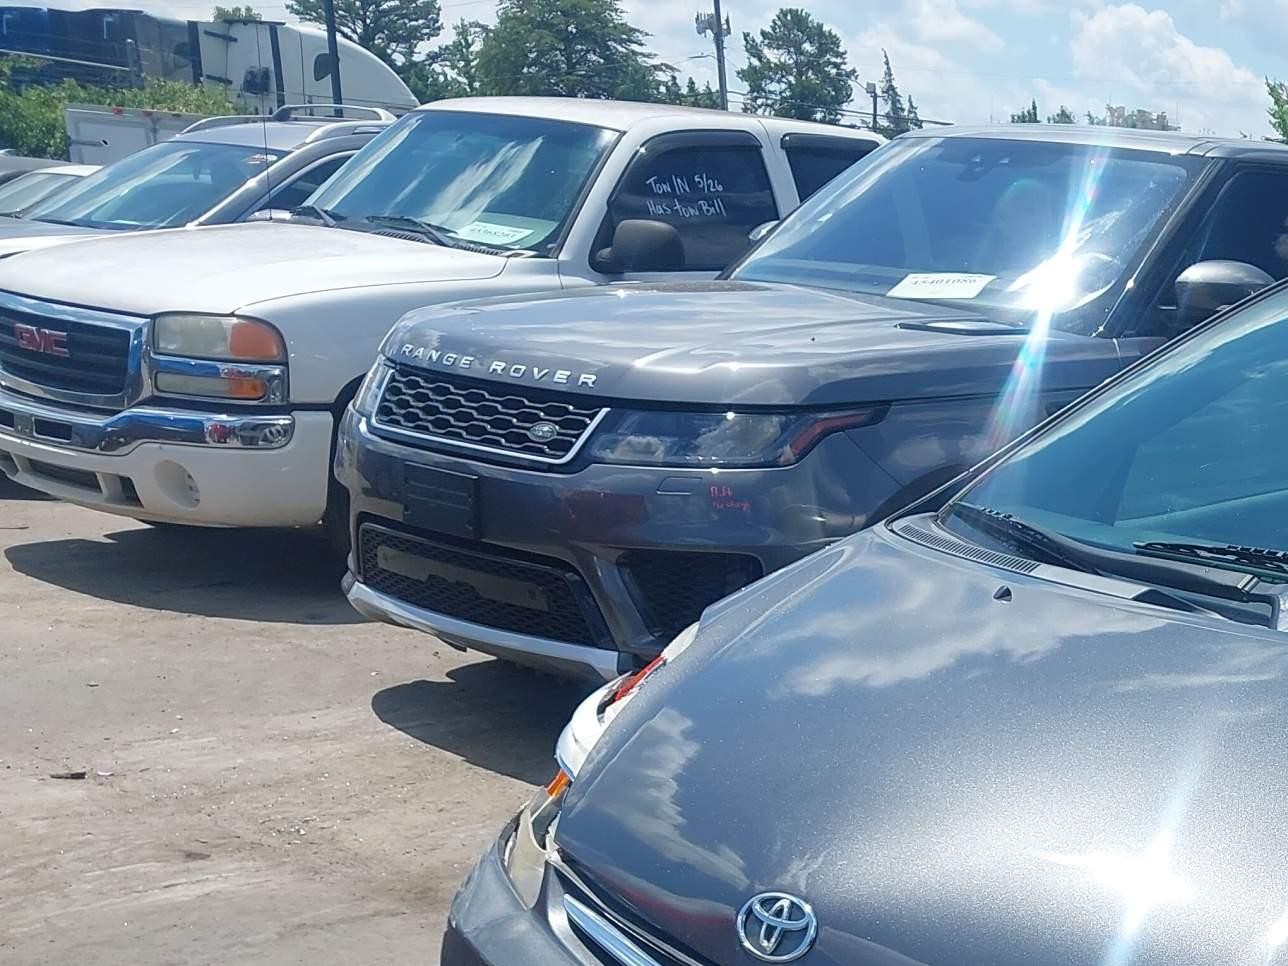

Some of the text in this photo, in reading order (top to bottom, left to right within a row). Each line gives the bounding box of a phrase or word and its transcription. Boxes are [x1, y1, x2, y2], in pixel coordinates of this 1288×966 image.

[694, 172, 723, 194] 5/26
[646, 199, 672, 216] Has
[698, 198, 727, 217] Bill
[15, 323, 70, 357] GMC
[401, 343, 598, 388] RANGE ROVER
